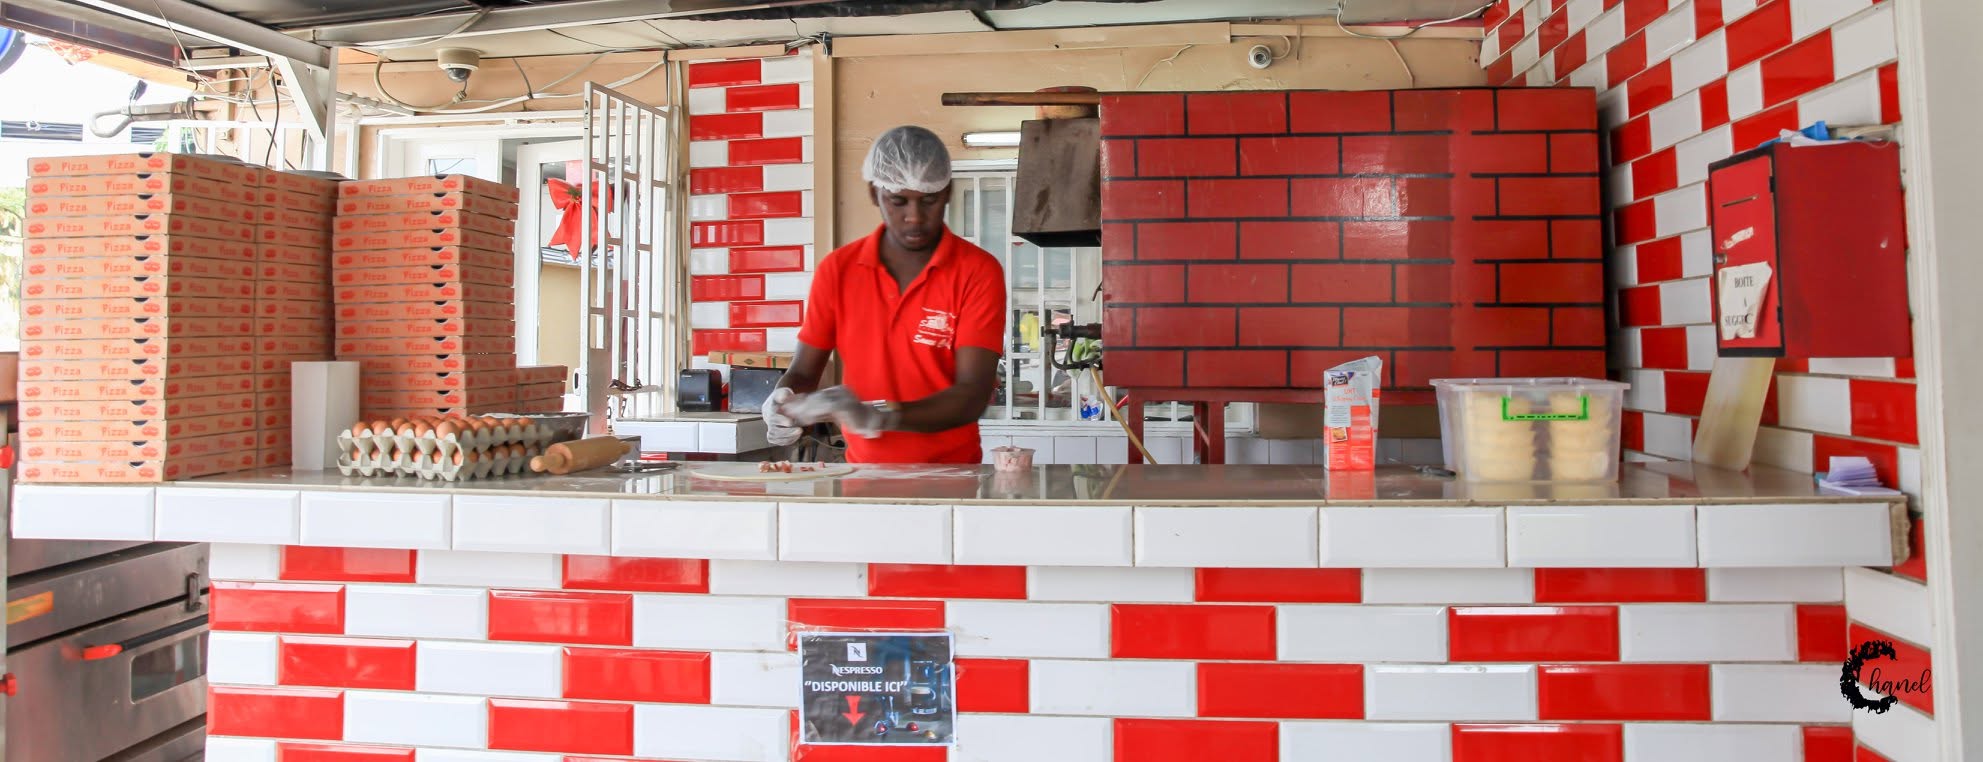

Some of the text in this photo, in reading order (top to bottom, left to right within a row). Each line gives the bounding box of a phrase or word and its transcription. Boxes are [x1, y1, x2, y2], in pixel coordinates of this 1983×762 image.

[62, 160, 135, 171] Pizza Pizza
[60, 181, 133, 192] Pizza Pizza
[368, 182, 432, 193] Pizza Pizza
[60, 201, 134, 212] Pizza Pizza
[367, 199, 430, 210] Pizza Pizza
[57, 221, 131, 232] Pizza Pizza
[363, 216, 427, 228] Pizza Pizza
[363, 234, 428, 245] Pizza Pizza
[58, 242, 131, 253] Pizza Pizza
[363, 253, 427, 263] Pizza Pizza
[57, 262, 131, 273] Pizza Pizza
[363, 271, 427, 281] Pizza Pizza
[56, 283, 130, 294] Pizza Pizza
[364, 288, 429, 298] Pizza Pizza
[56, 303, 130, 314] Pizza Pizza
[365, 306, 430, 316] Pizza Pizza
[54, 324, 130, 334] Pizza Pizza
[366, 324, 432, 334] Pizza Pizza
[55, 345, 130, 355] Pizza Pizza
[365, 342, 429, 351] Pizza Pizza
[408, 359, 432, 368] Pizza
[54, 365, 128, 376] Pizza Pizza
[408, 377, 432, 385] Pizza
[53, 386, 127, 396] Pizza Pizza
[408, 395, 433, 404] Pizza
[54, 406, 128, 416] Pizza Pizza
[55, 426, 129, 436] Pizza Pizza
[55, 447, 128, 457] Pizza Pizza
[52, 468, 126, 478] Pizza Pizza
[829, 664, 883, 676] NESPRESSO
